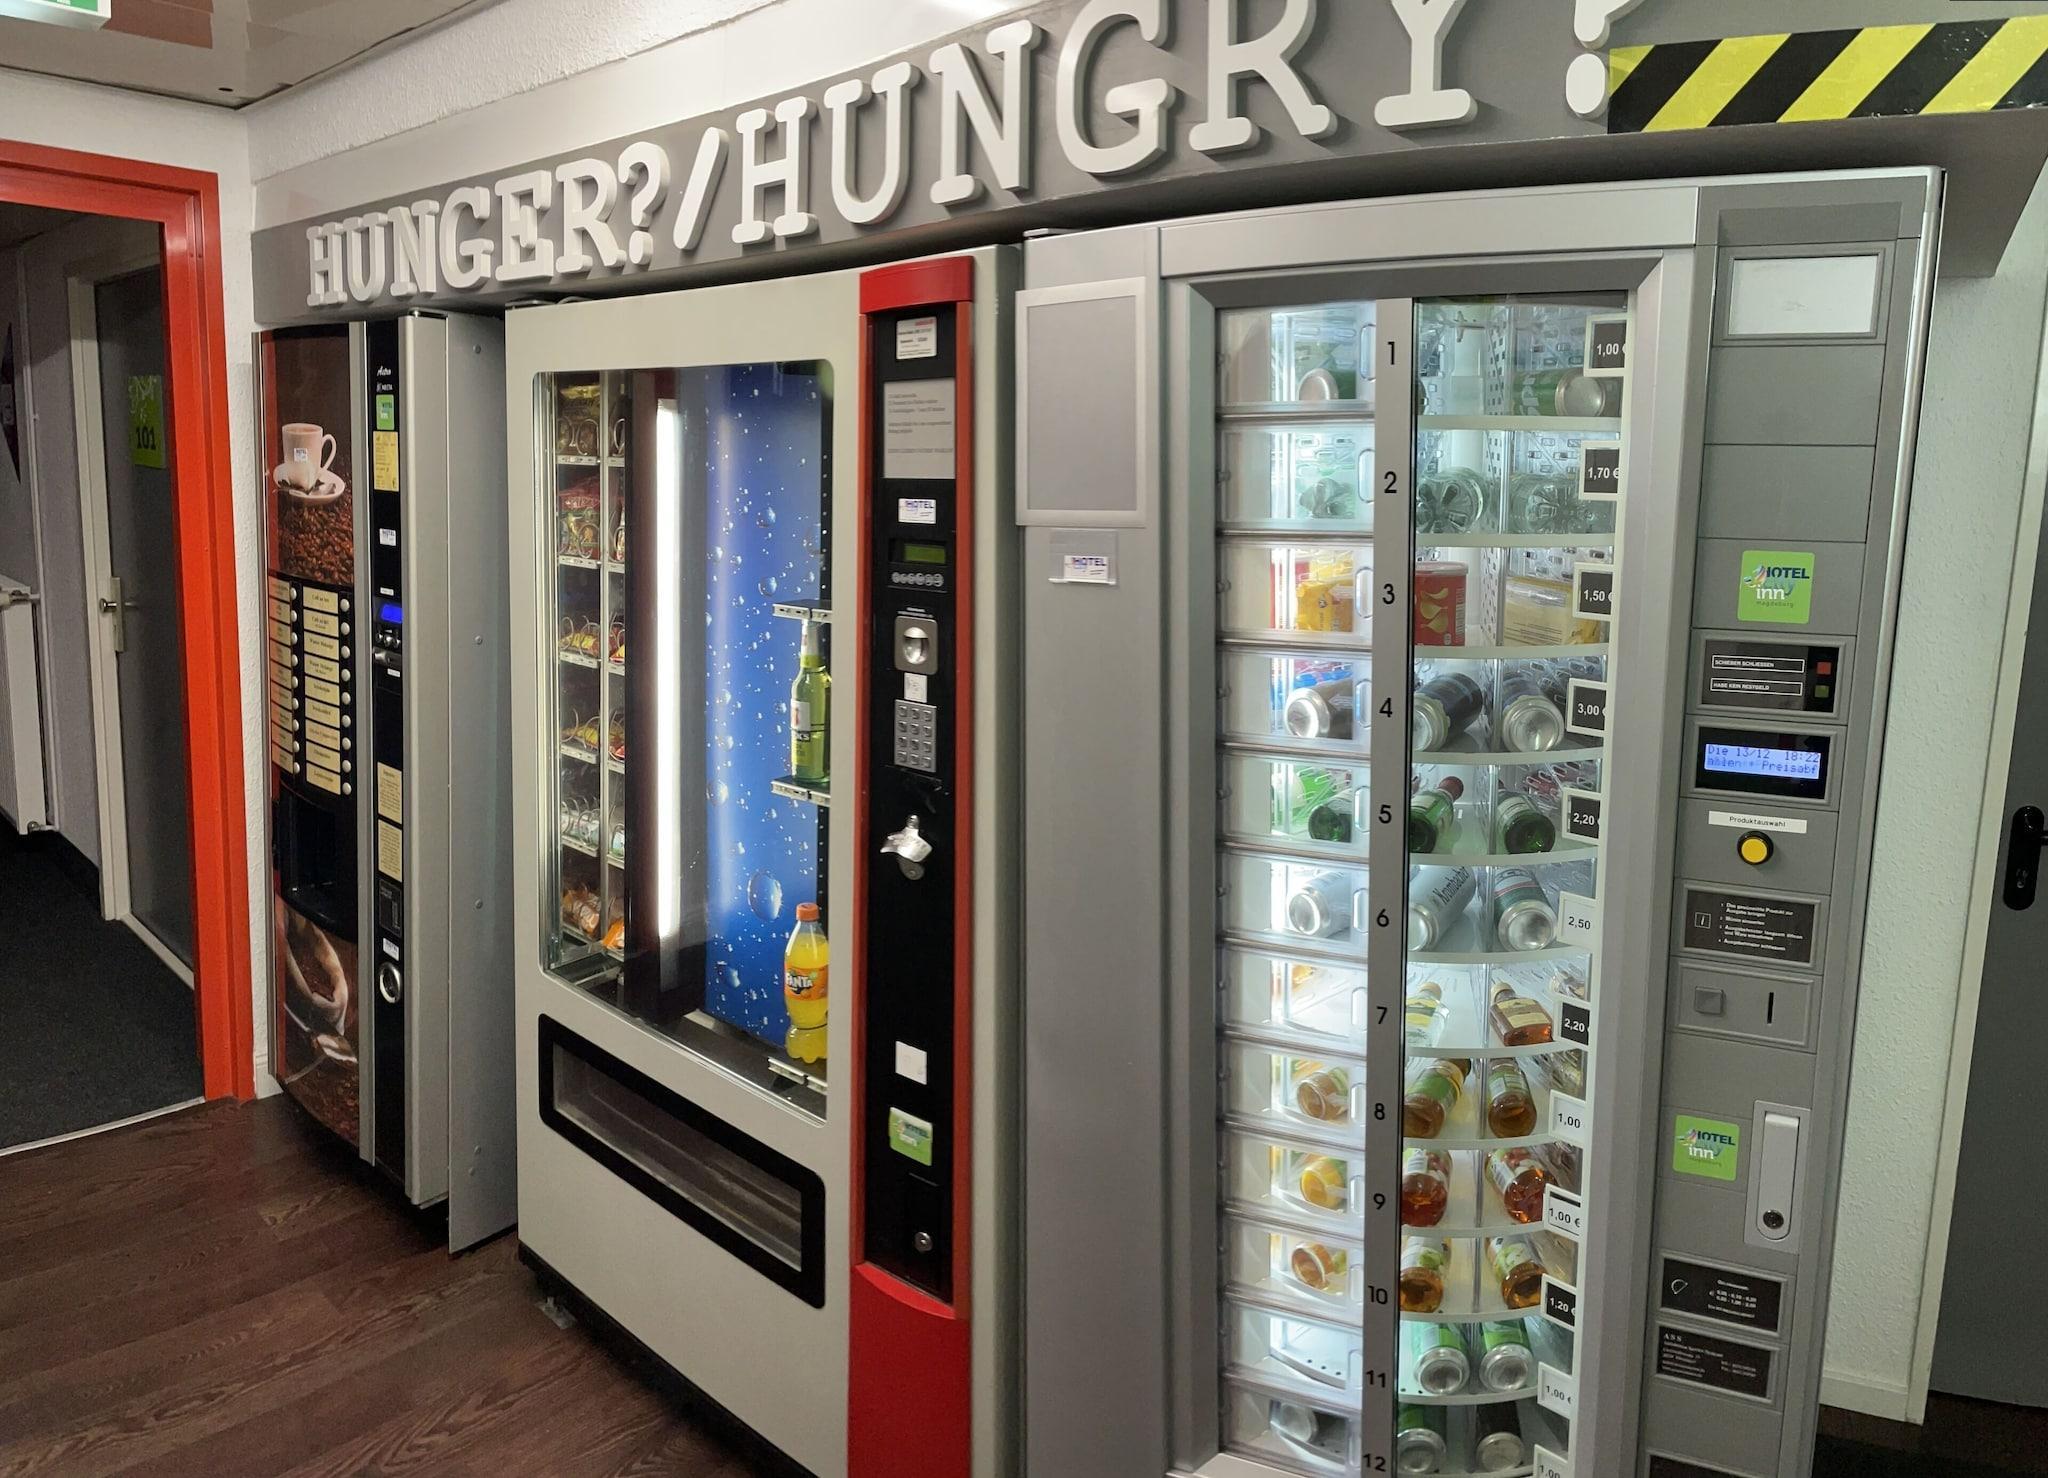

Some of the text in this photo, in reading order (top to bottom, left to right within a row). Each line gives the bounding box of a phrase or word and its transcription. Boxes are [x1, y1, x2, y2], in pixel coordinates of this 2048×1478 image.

[1387, 341, 1396, 365] 1
[1596, 343, 1620, 357] 1,00
[136, 425, 156, 450] 101
[1384, 470, 1398, 494] 2
[1587, 466, 1620, 480] 1,70 €
[1382, 583, 1395, 605] 3
[1583, 588, 1606, 603] 1,50
[1756, 584, 1785, 600] inn
[1379, 697, 1393, 718] 4
[1577, 703, 1600, 717] 3,00
[1708, 744, 1820, 763] Die 13/12 18:22
[1378, 804, 1392, 824] 5
[1572, 812, 1595, 826] 2,20
[1729, 815, 1786, 828] Produktauswahl
[1376, 907, 1390, 928] 6
[1568, 916, 1591, 931] 2,50
[1376, 1006, 1388, 1025] 7
[1564, 1017, 1586, 1032] 2,20
[1374, 1102, 1386, 1121] 8
[1557, 1112, 1581, 1129] 1,00
[1688, 1144, 1714, 1160] inn
[1373, 1192, 1386, 1211] 9
[1549, 1207, 1581, 1228] 1,00 €
[1368, 1285, 1388, 1305] 10
[1549, 1297, 1569, 1313] 1,20
[1366, 1369, 1387, 1388] 11
[1362, 1453, 1387, 1472] 12
